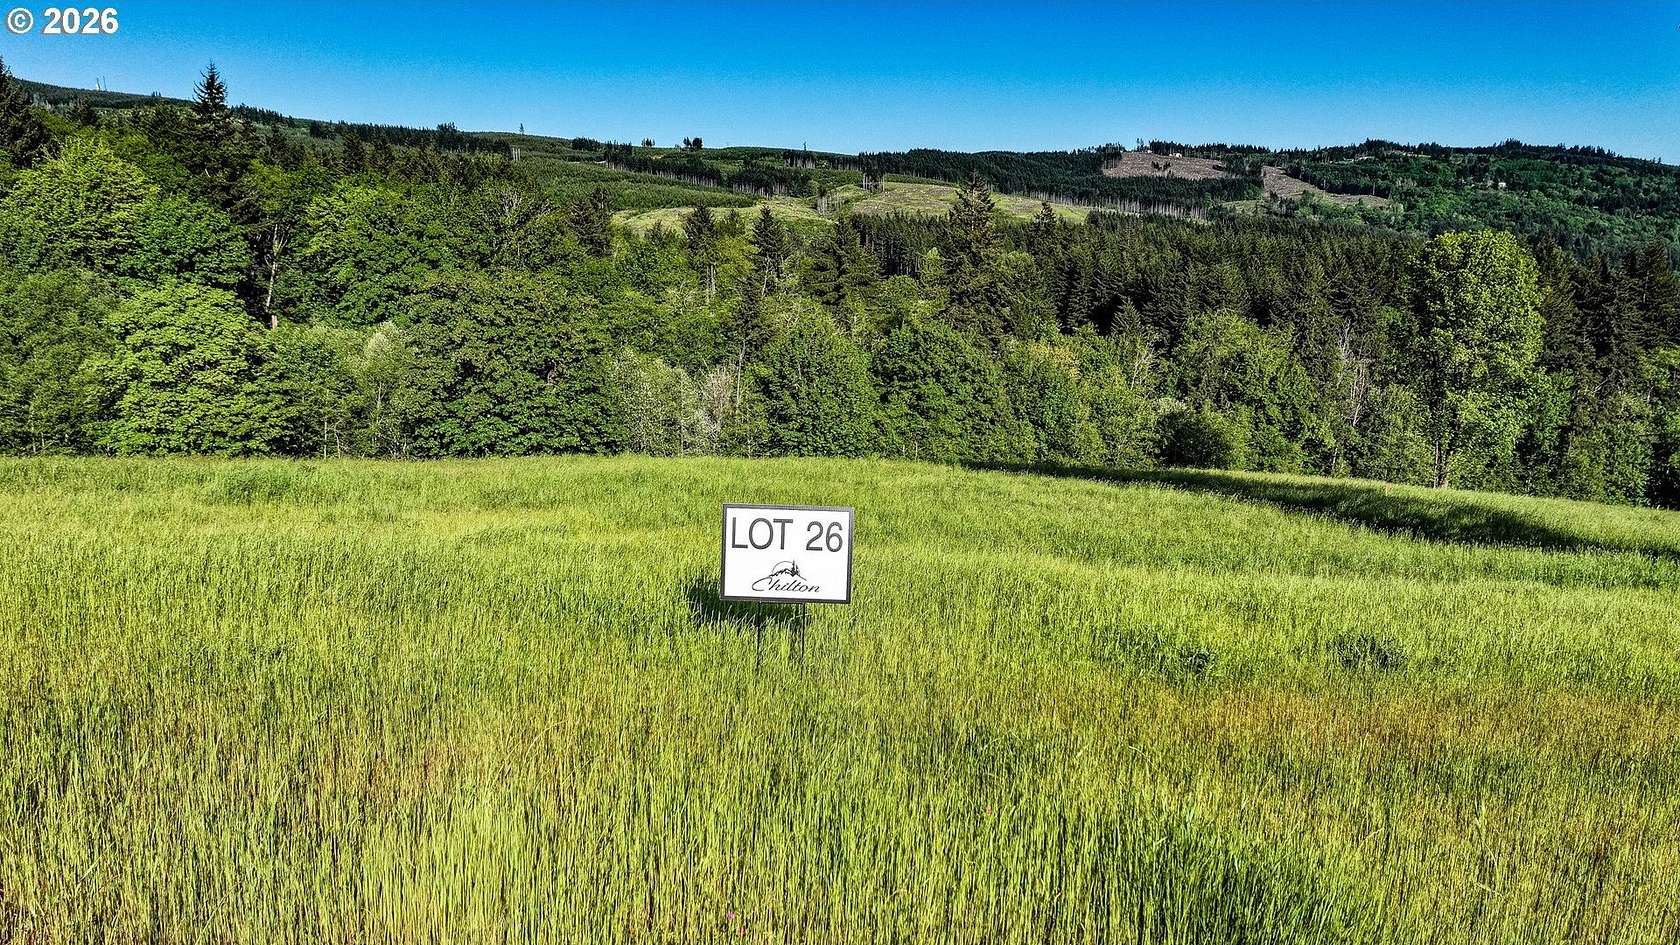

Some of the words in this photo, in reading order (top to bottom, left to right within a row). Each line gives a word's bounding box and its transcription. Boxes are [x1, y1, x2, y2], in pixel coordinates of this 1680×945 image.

[731, 517, 794, 550] LOT
[806, 521, 843, 552] 26
[752, 576, 820, 592] Chilton
